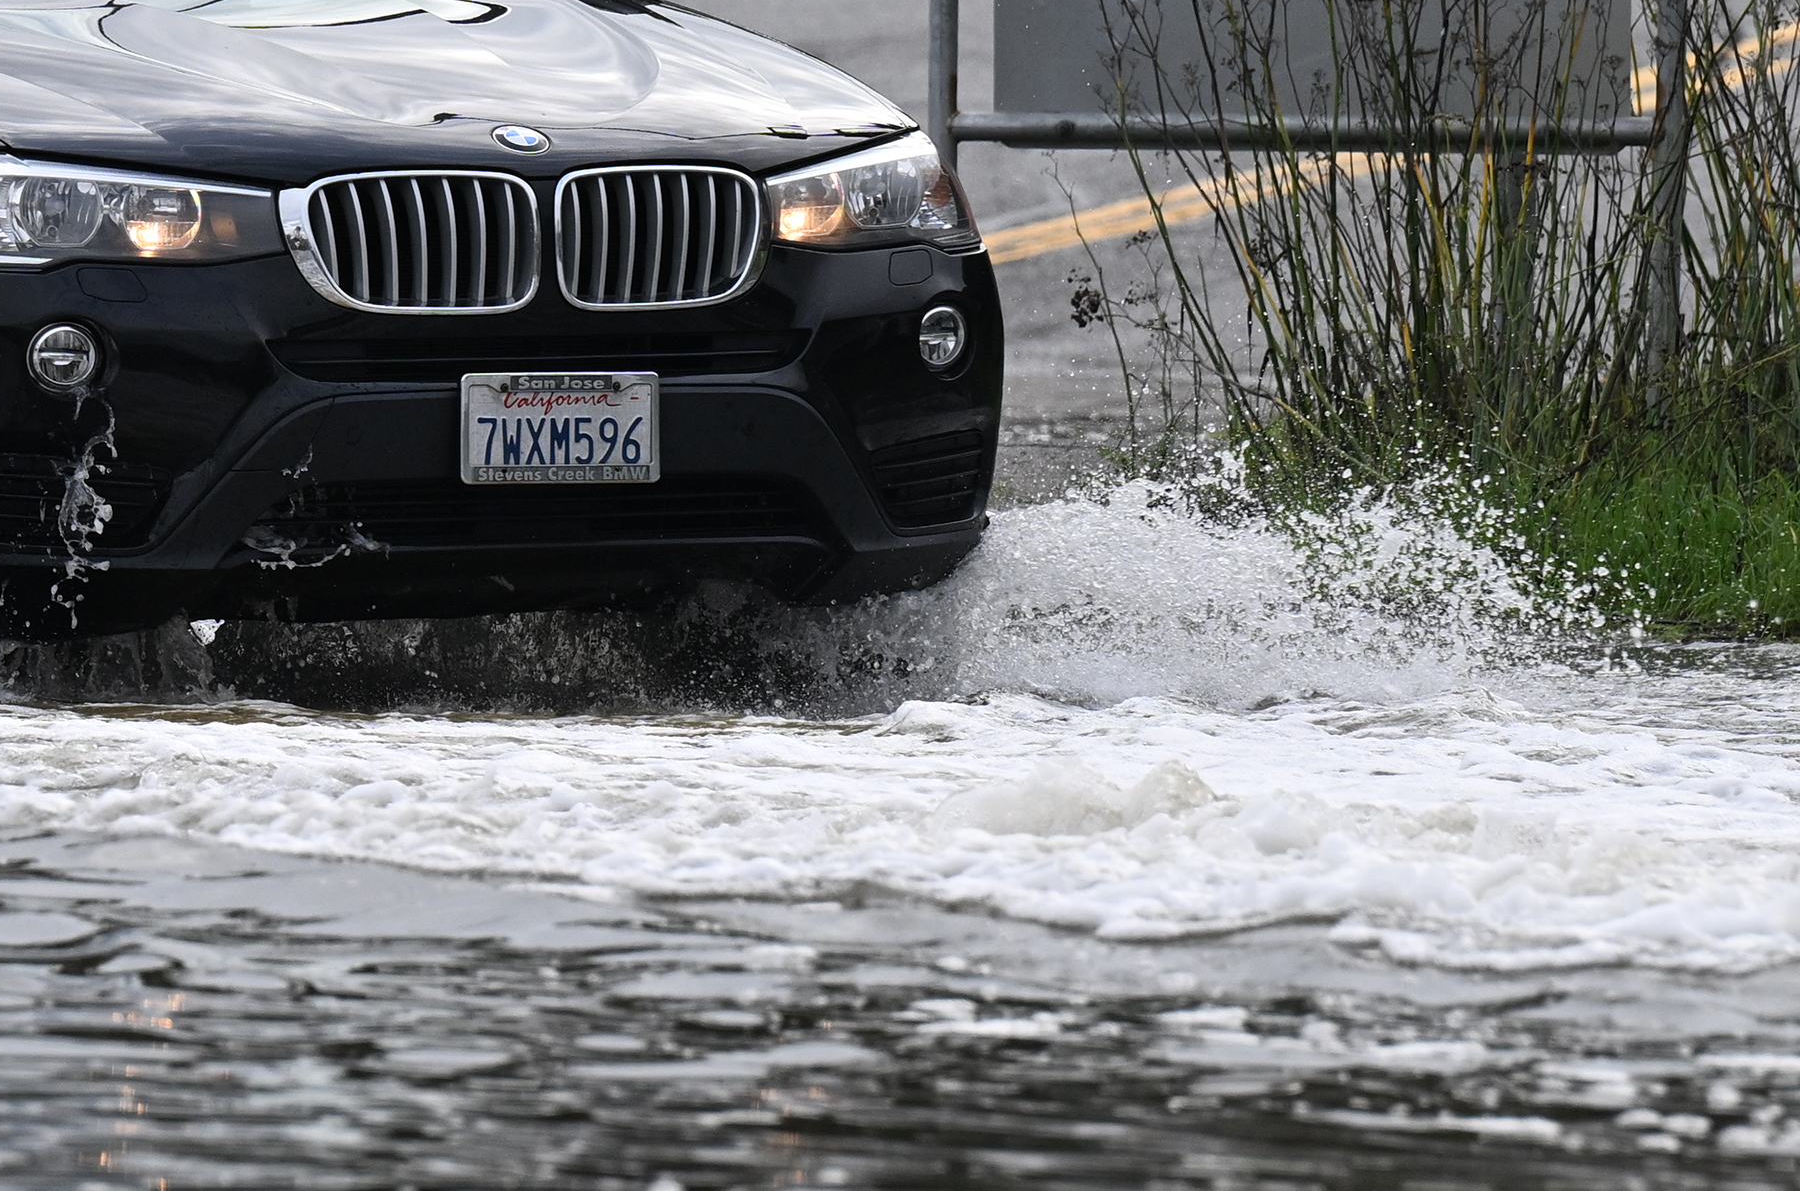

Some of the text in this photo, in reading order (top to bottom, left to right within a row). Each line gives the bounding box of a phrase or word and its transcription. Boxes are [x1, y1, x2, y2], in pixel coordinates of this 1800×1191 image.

[518, 375, 605, 390] San Jose
[503, 391, 622, 416] California
[476, 416, 644, 466] 7WXM596
[478, 466, 648, 481] Stevens Creek BMW
